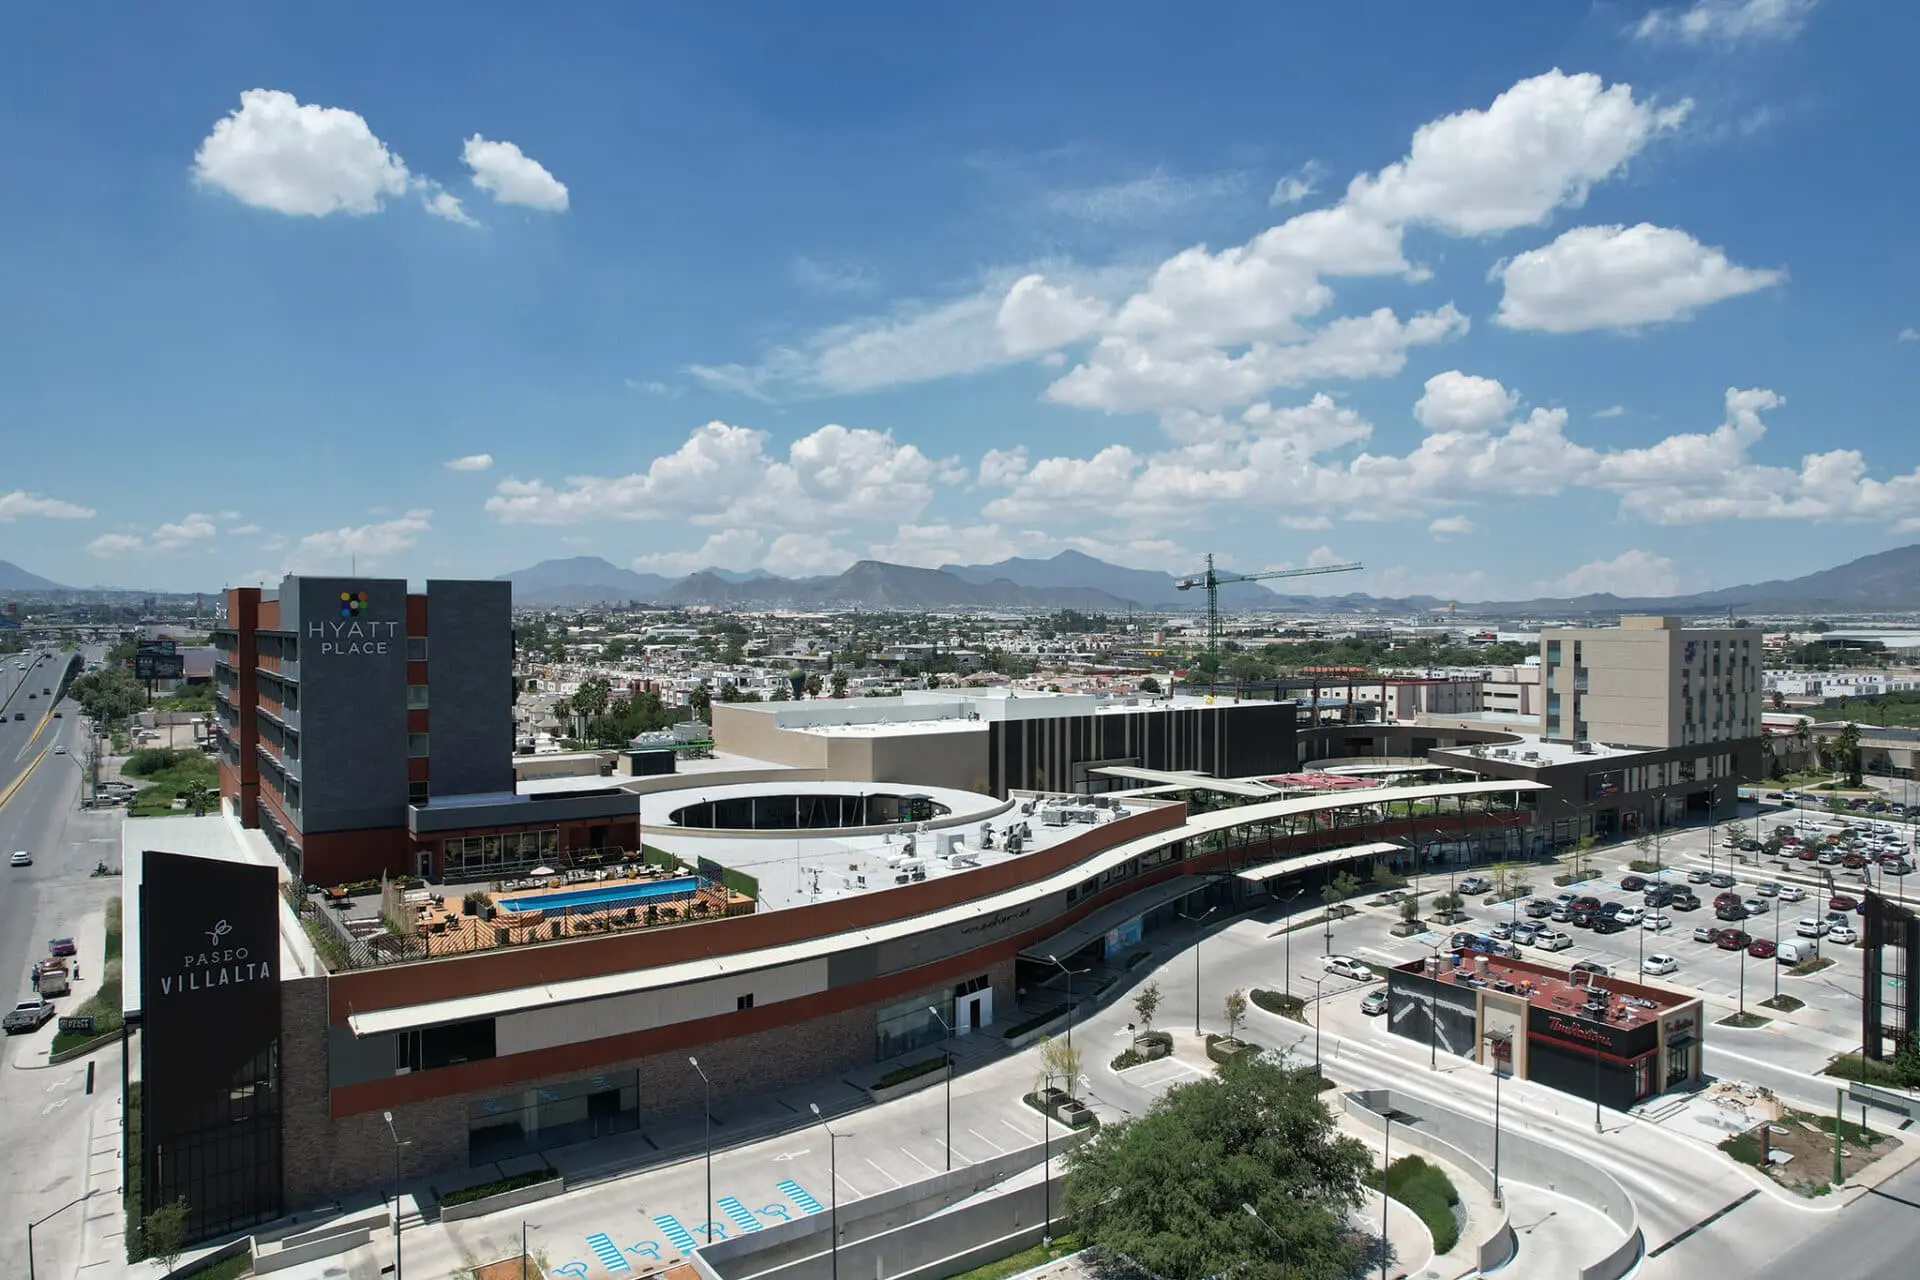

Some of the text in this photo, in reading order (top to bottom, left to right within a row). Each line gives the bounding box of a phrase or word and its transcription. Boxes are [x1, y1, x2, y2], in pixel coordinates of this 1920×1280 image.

[309, 621, 398, 638] HYATT
[321, 642, 387, 655] PLACE
[184, 947, 248, 967] PASEO
[160, 961, 270, 995] VILLALTA
